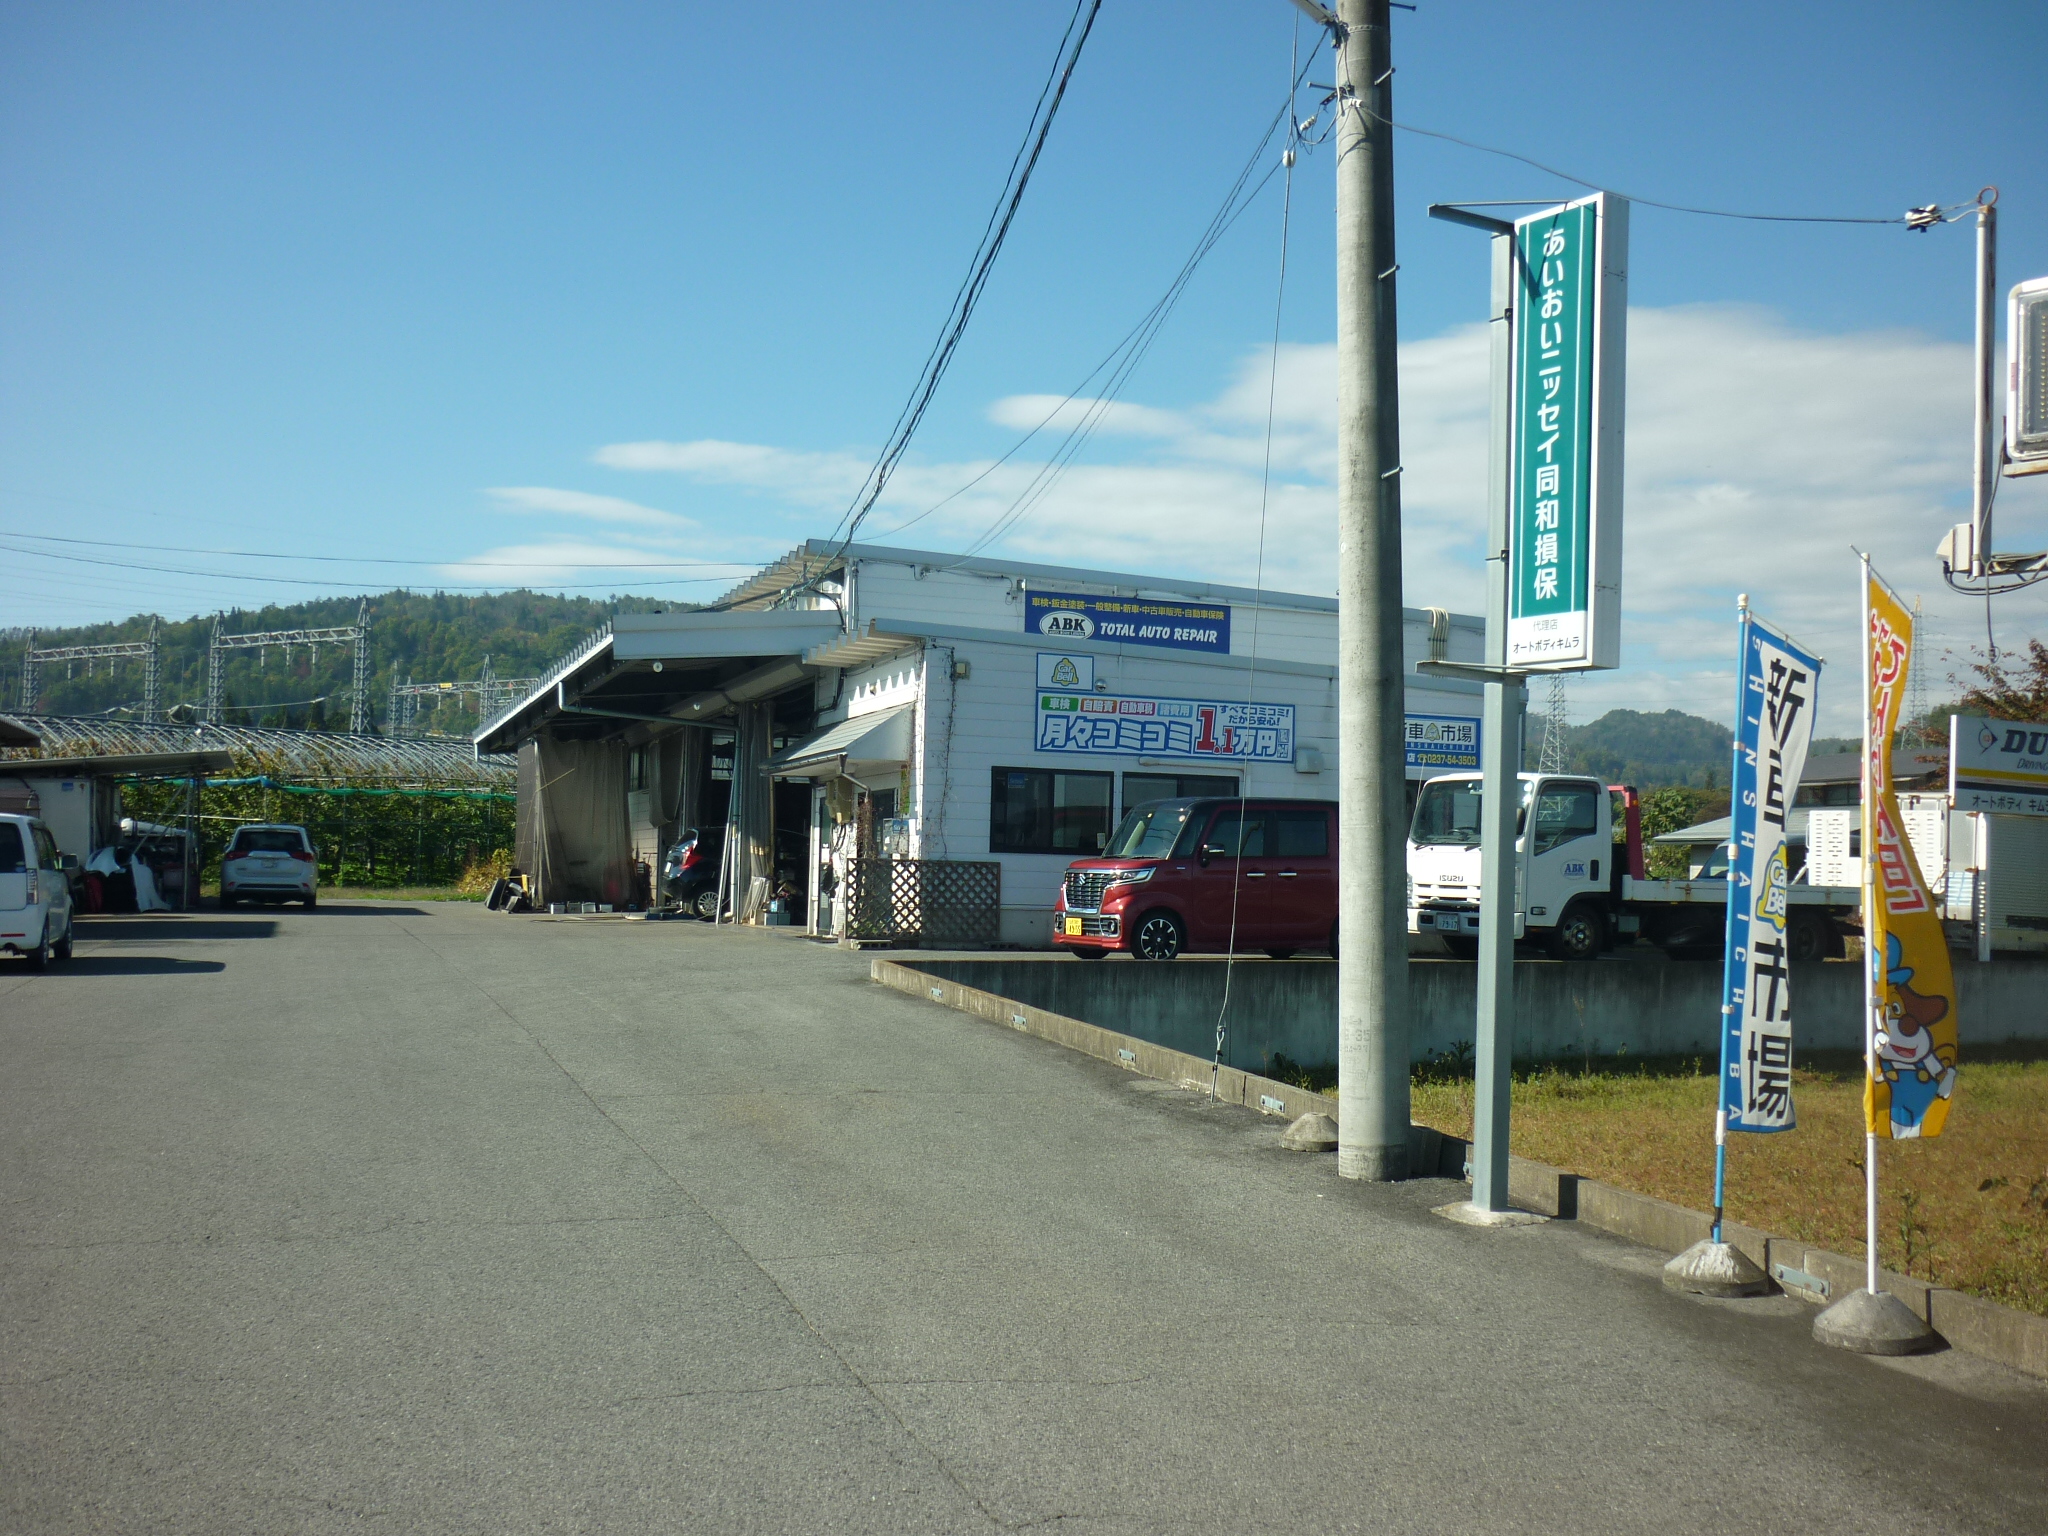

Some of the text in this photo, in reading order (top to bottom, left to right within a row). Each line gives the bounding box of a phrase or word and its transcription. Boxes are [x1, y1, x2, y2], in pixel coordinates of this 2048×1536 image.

[1533, 228, 1565, 600] あいおいニッセイ同和損保
[1048, 617, 1086, 631] ABK
[1533, 619, 1558, 632] 代理店
[1100, 622, 1136, 637] TOTAL
[1139, 625, 1171, 640] AUTO
[1174, 628, 1217, 644] REPAIR
[1513, 636, 1579, 654] オートボディキムラ
[1049, 698, 1070, 710] 車検
[1120, 701, 1153, 715] 自動車税
[1160, 703, 1190, 716] 諸費用
[1441, 724, 1472, 743] 市場
[1407, 752, 1415, 763] 店
[1972, 795, 2022, 810] オートボディ
[1564, 863, 1585, 873] ABK
[1439, 874, 1464, 882] ISUZU
[1748, 937, 1790, 1119] 市場
